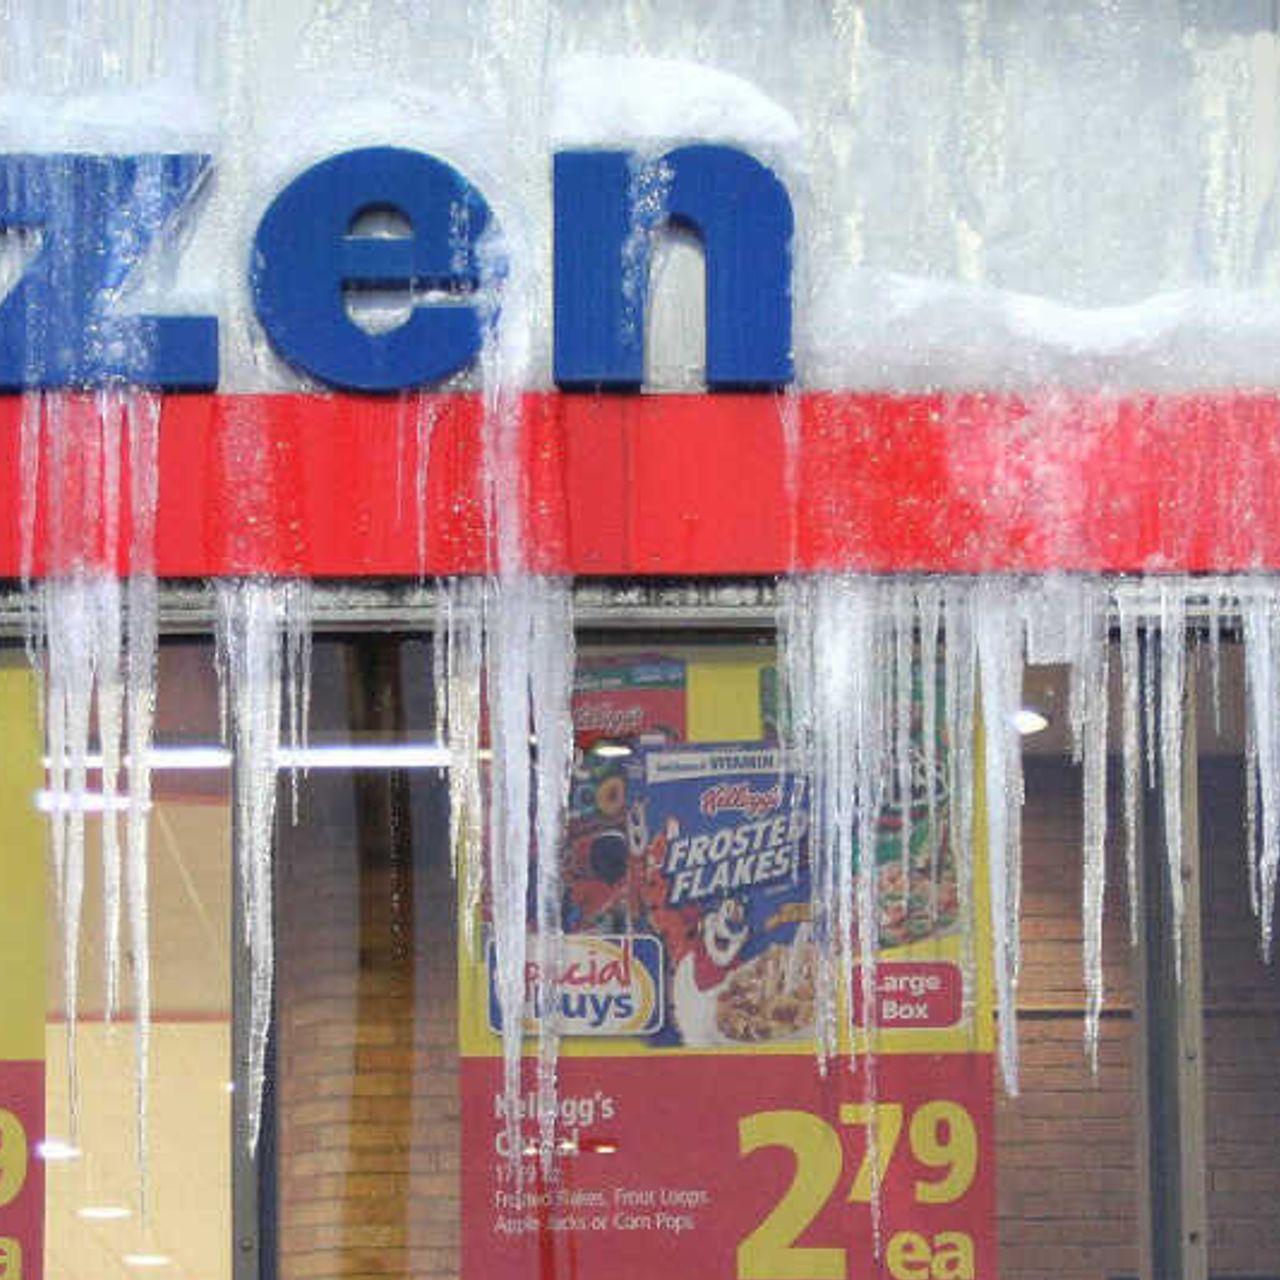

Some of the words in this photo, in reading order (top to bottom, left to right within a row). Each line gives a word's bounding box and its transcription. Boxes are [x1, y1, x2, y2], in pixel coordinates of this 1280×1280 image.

[670, 809, 809, 873] FROSTED
[670, 846, 793, 903] FLAKES
[882, 999, 929, 1020] Box
